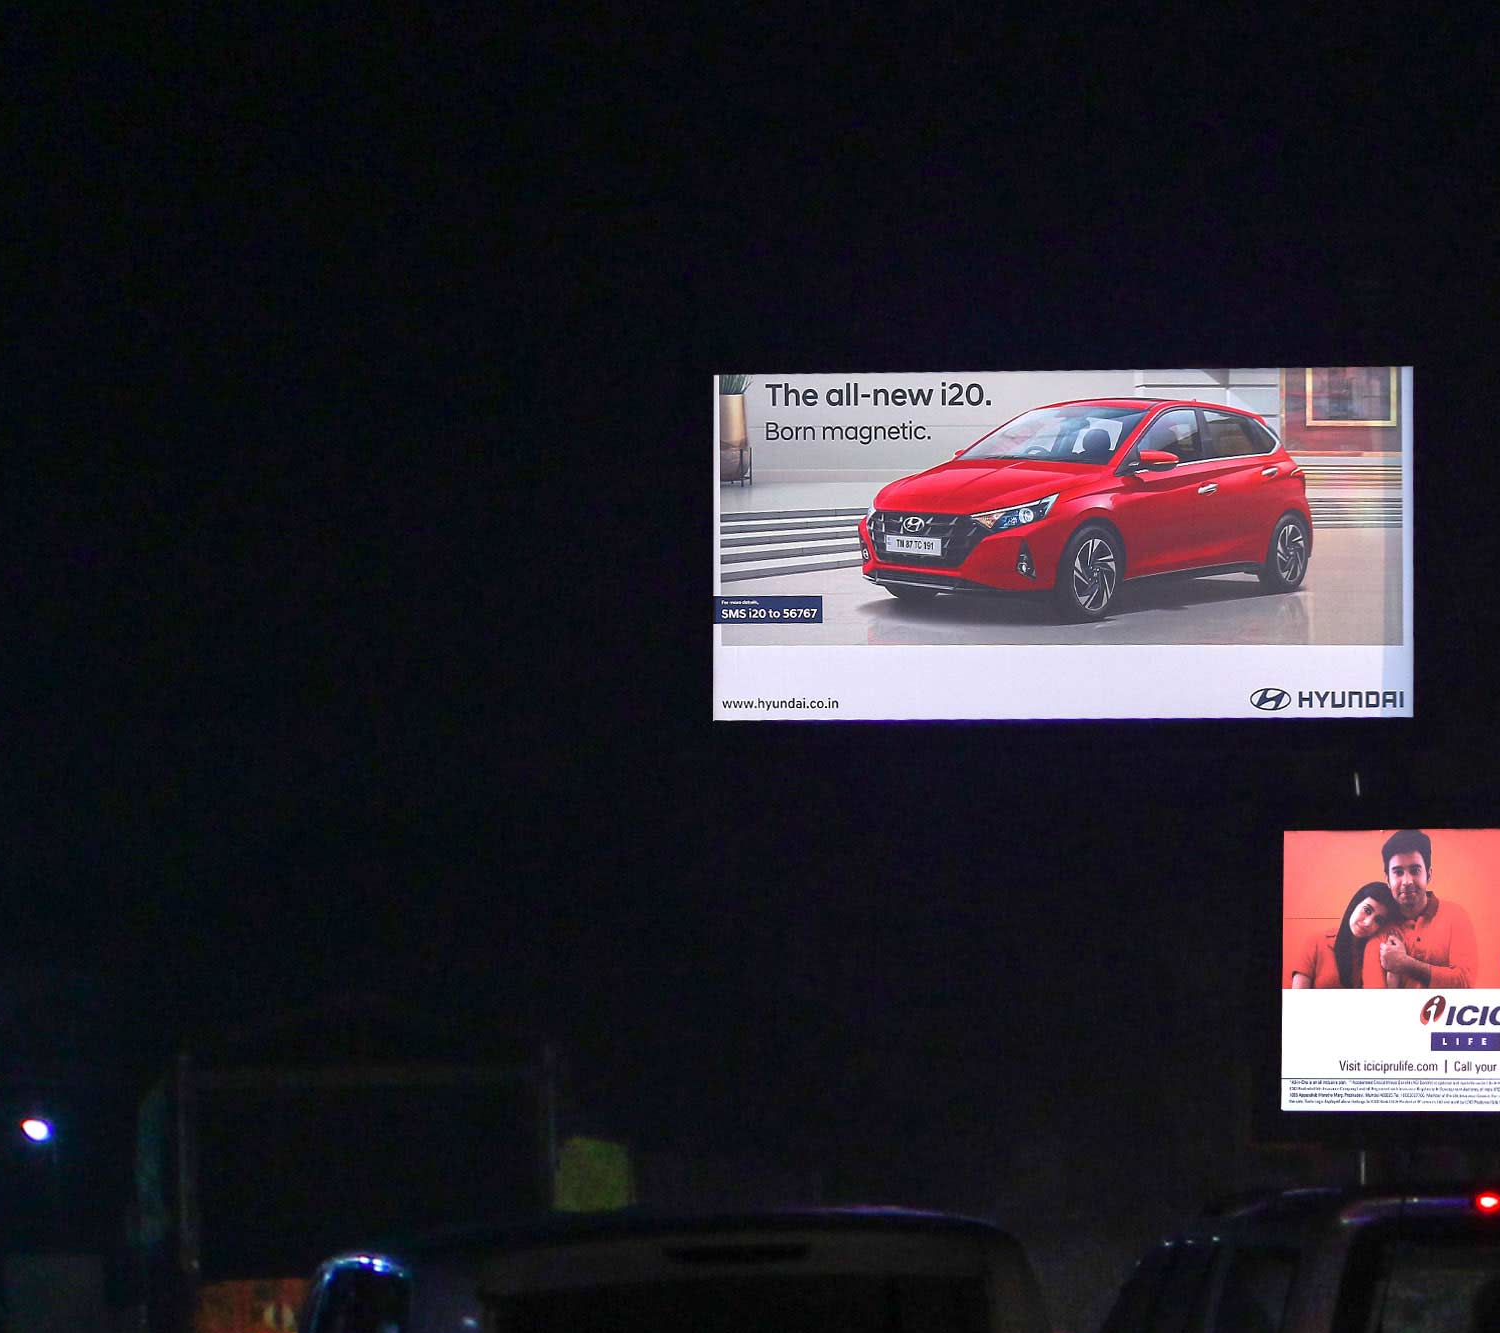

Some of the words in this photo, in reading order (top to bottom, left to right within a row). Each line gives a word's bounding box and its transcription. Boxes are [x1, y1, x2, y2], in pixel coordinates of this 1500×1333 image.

[765, 383, 818, 407] The
[825, 382, 934, 407] all-new
[941, 382, 992, 407] i20.
[765, 422, 816, 441] Born
[822, 420, 932, 445] magnetic.
[905, 540, 913, 549] 87
[915, 540, 923, 549] TC
[923, 541, 934, 551] 191
[721, 608, 747, 619] SMS
[748, 608, 767, 619] i20
[768, 609, 781, 619] to
[782, 608, 818, 619] 56767
[722, 697, 839, 711] www.hyundai.co.in
[1298, 691, 1405, 708] HYUNDAI
[1442, 1037, 1488, 1046] LIFE
[1339, 1060, 1361, 1072] Visit
[1363, 1060, 1439, 1075] iciciprulife.com
[1454, 1060, 1473, 1072] Call
[1474, 1062, 1498, 1075] your
